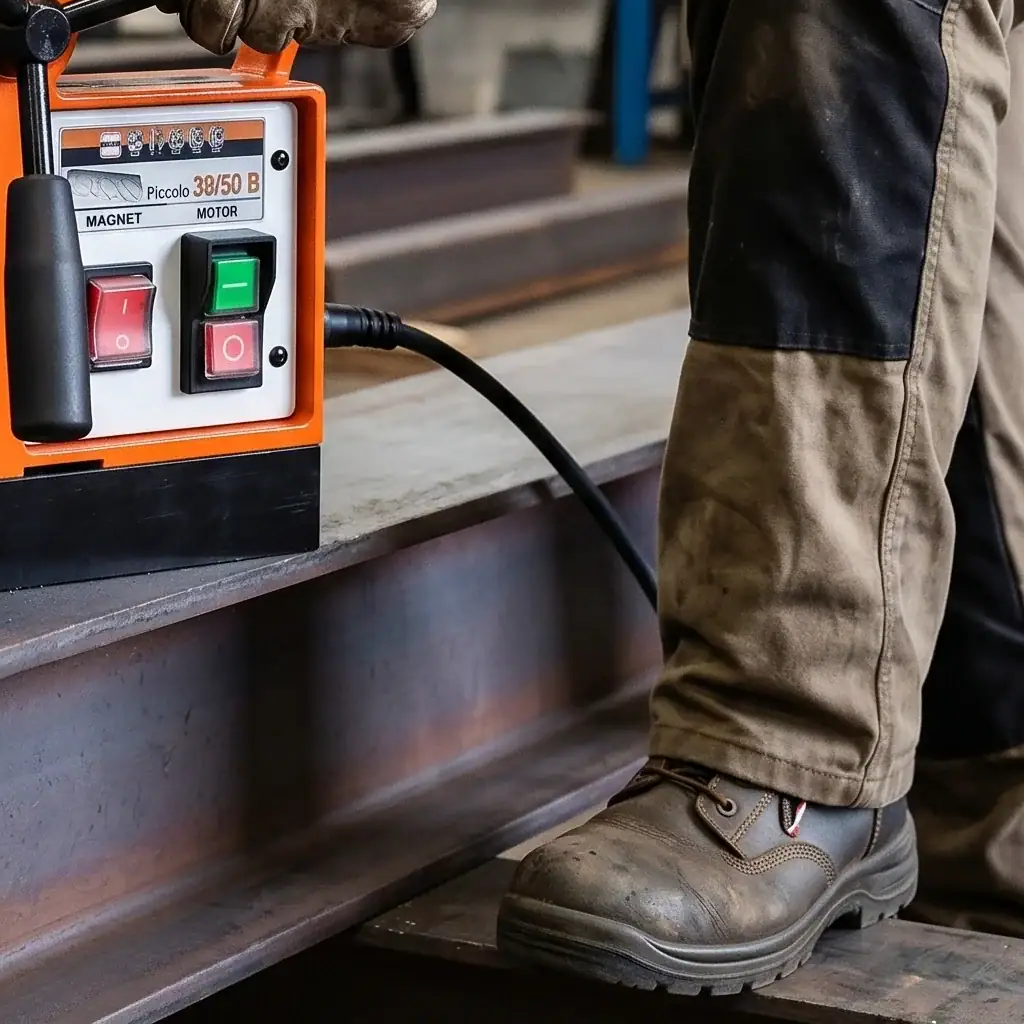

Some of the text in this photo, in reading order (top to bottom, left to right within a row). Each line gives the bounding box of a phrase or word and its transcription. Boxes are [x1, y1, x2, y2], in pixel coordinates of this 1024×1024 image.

[146, 172, 260, 200] Piccolo 38/50 B
[86, 212, 143, 228] MAGNET
[196, 205, 238, 219] MOTOR
